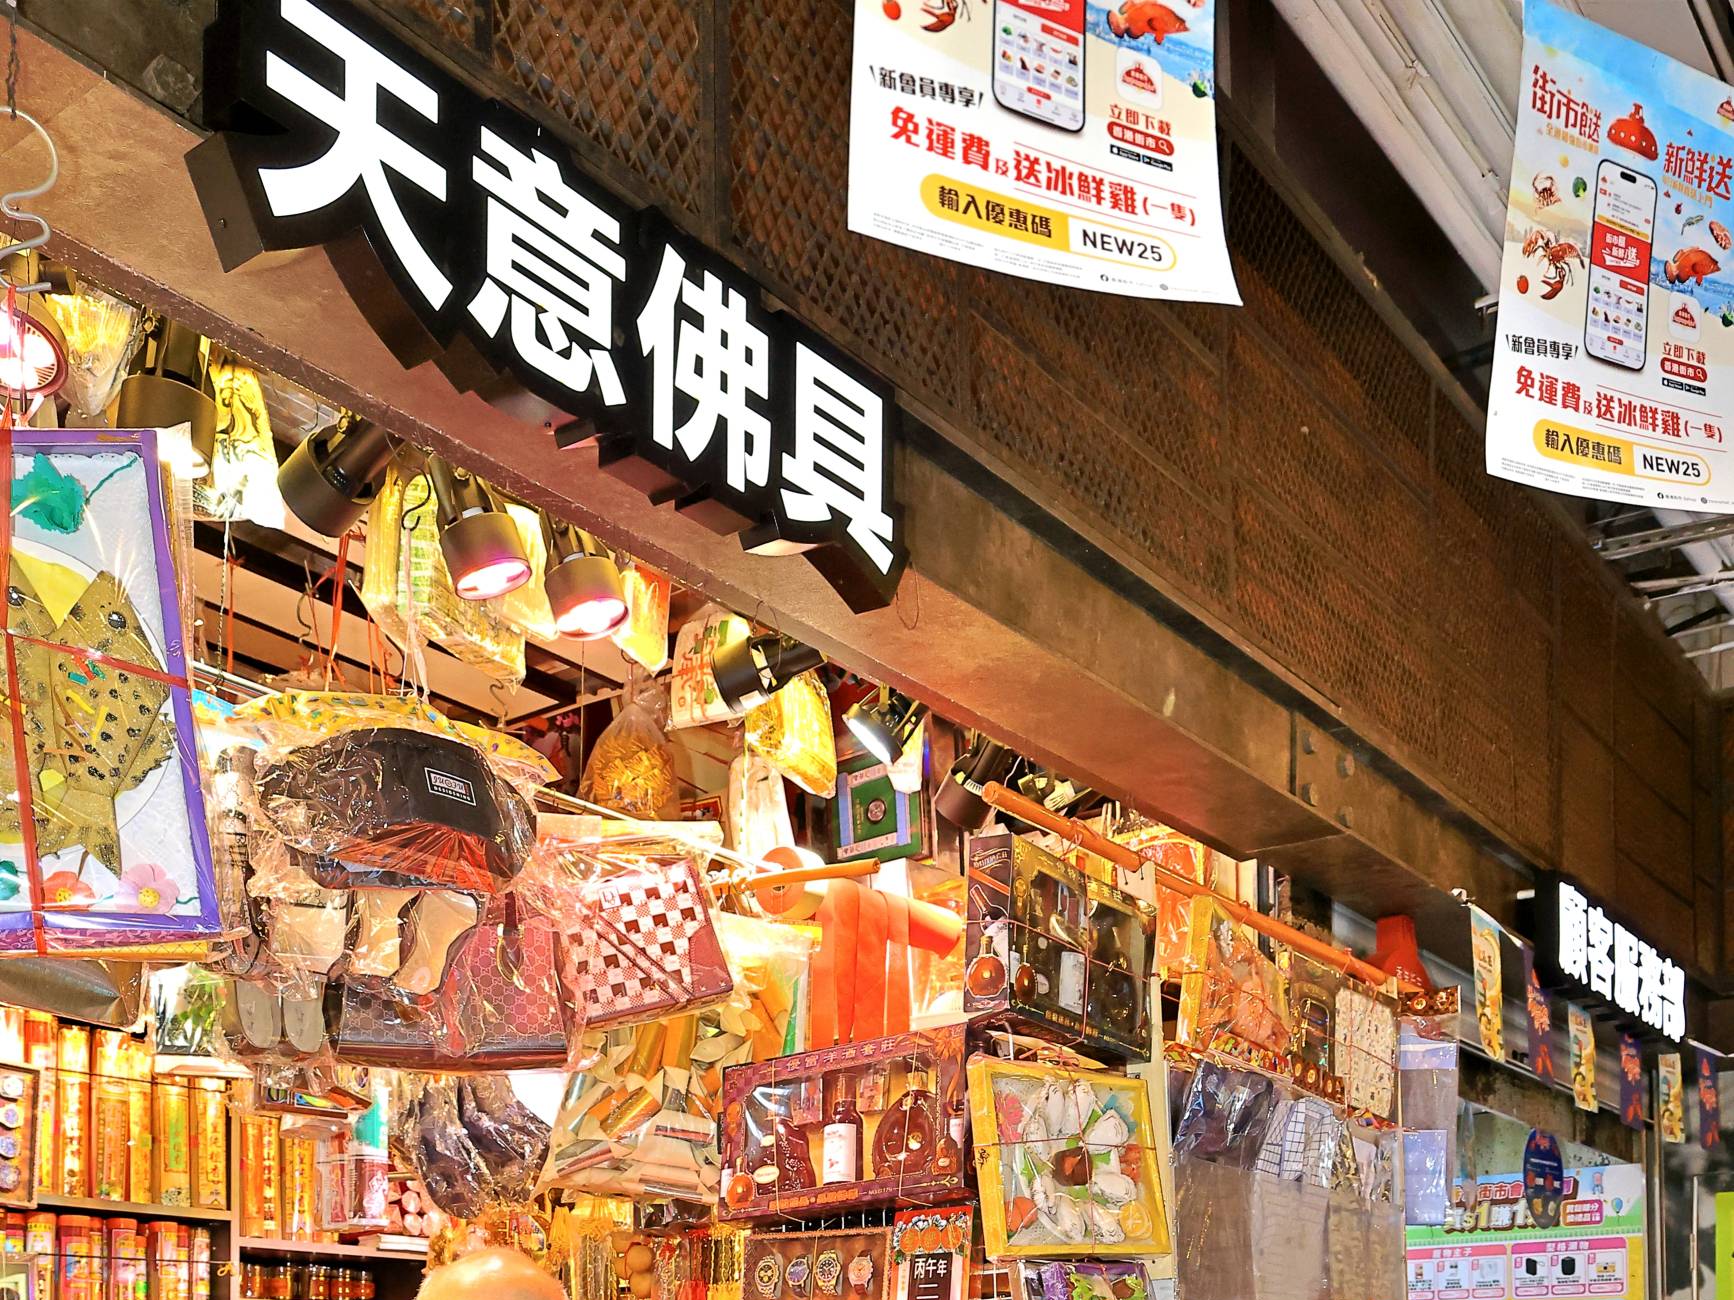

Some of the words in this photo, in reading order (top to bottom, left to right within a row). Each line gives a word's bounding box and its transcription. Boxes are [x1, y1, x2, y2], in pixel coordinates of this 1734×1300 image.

[1109, 103, 1172, 137] 立即下載
[938, 185, 1053, 239] 輸入優惠碼
[1081, 229, 1163, 263] NEW25
[257, 0, 896, 576] 天意佛具
[1662, 341, 1707, 366] 立即下載
[1544, 428, 1623, 466] 輸入優惠碼
[1642, 453, 1701, 478] NEW25
[913, 1257, 948, 1280] 丙午年
